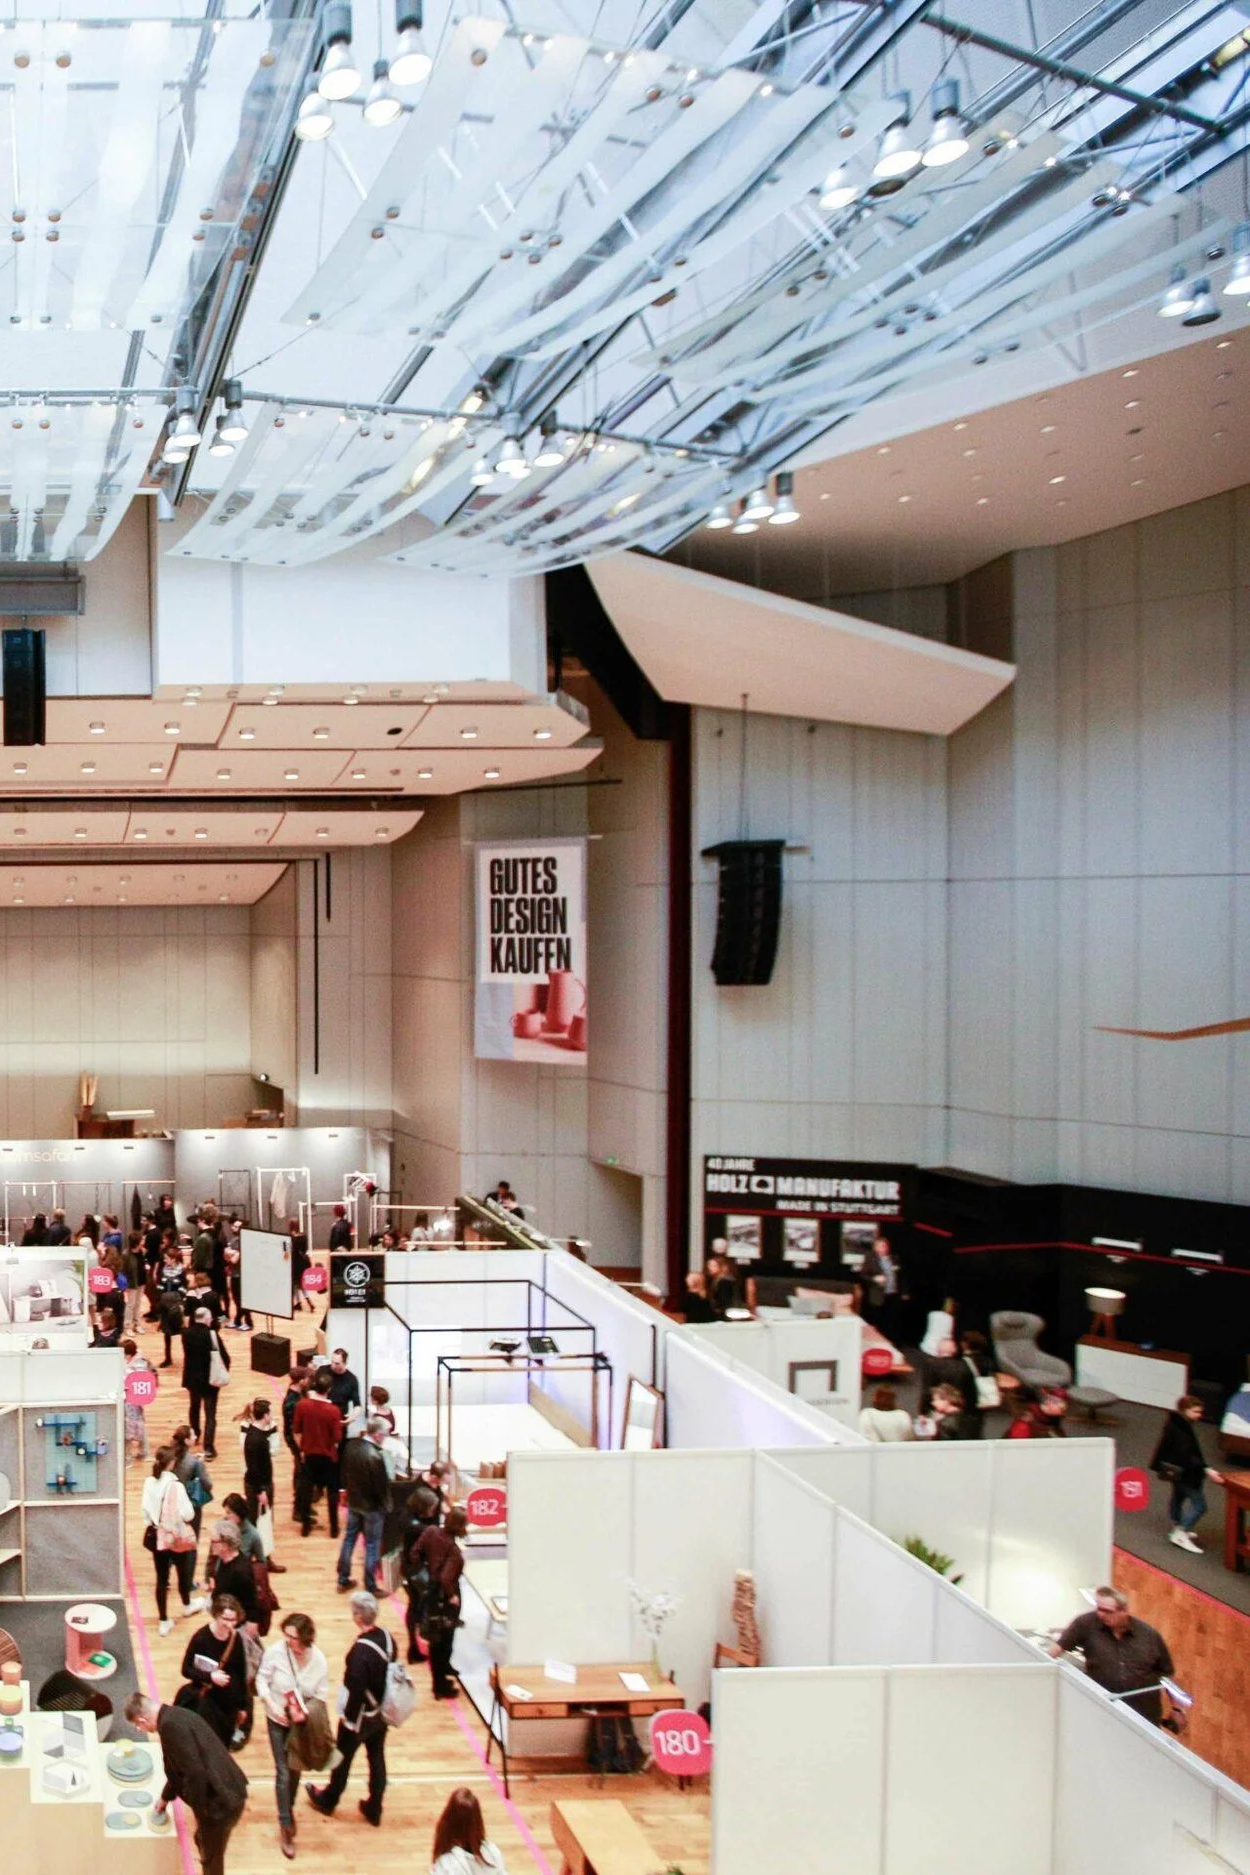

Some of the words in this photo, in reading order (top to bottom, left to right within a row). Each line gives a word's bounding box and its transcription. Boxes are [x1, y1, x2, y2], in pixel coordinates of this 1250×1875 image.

[489, 857, 558, 895] GUTES
[489, 897, 568, 934] DESIGN
[490, 937, 572, 974] KAUFEN
[706, 1173, 749, 1193] HOLZ
[776, 1176, 900, 1200] MANUFAKTUR
[775, 1200, 812, 1212] MADE
[93, 1275, 111, 1286] 183
[131, 1381, 152, 1395] 181
[470, 1499, 499, 1516] 182
[654, 1729, 700, 1756] 180
